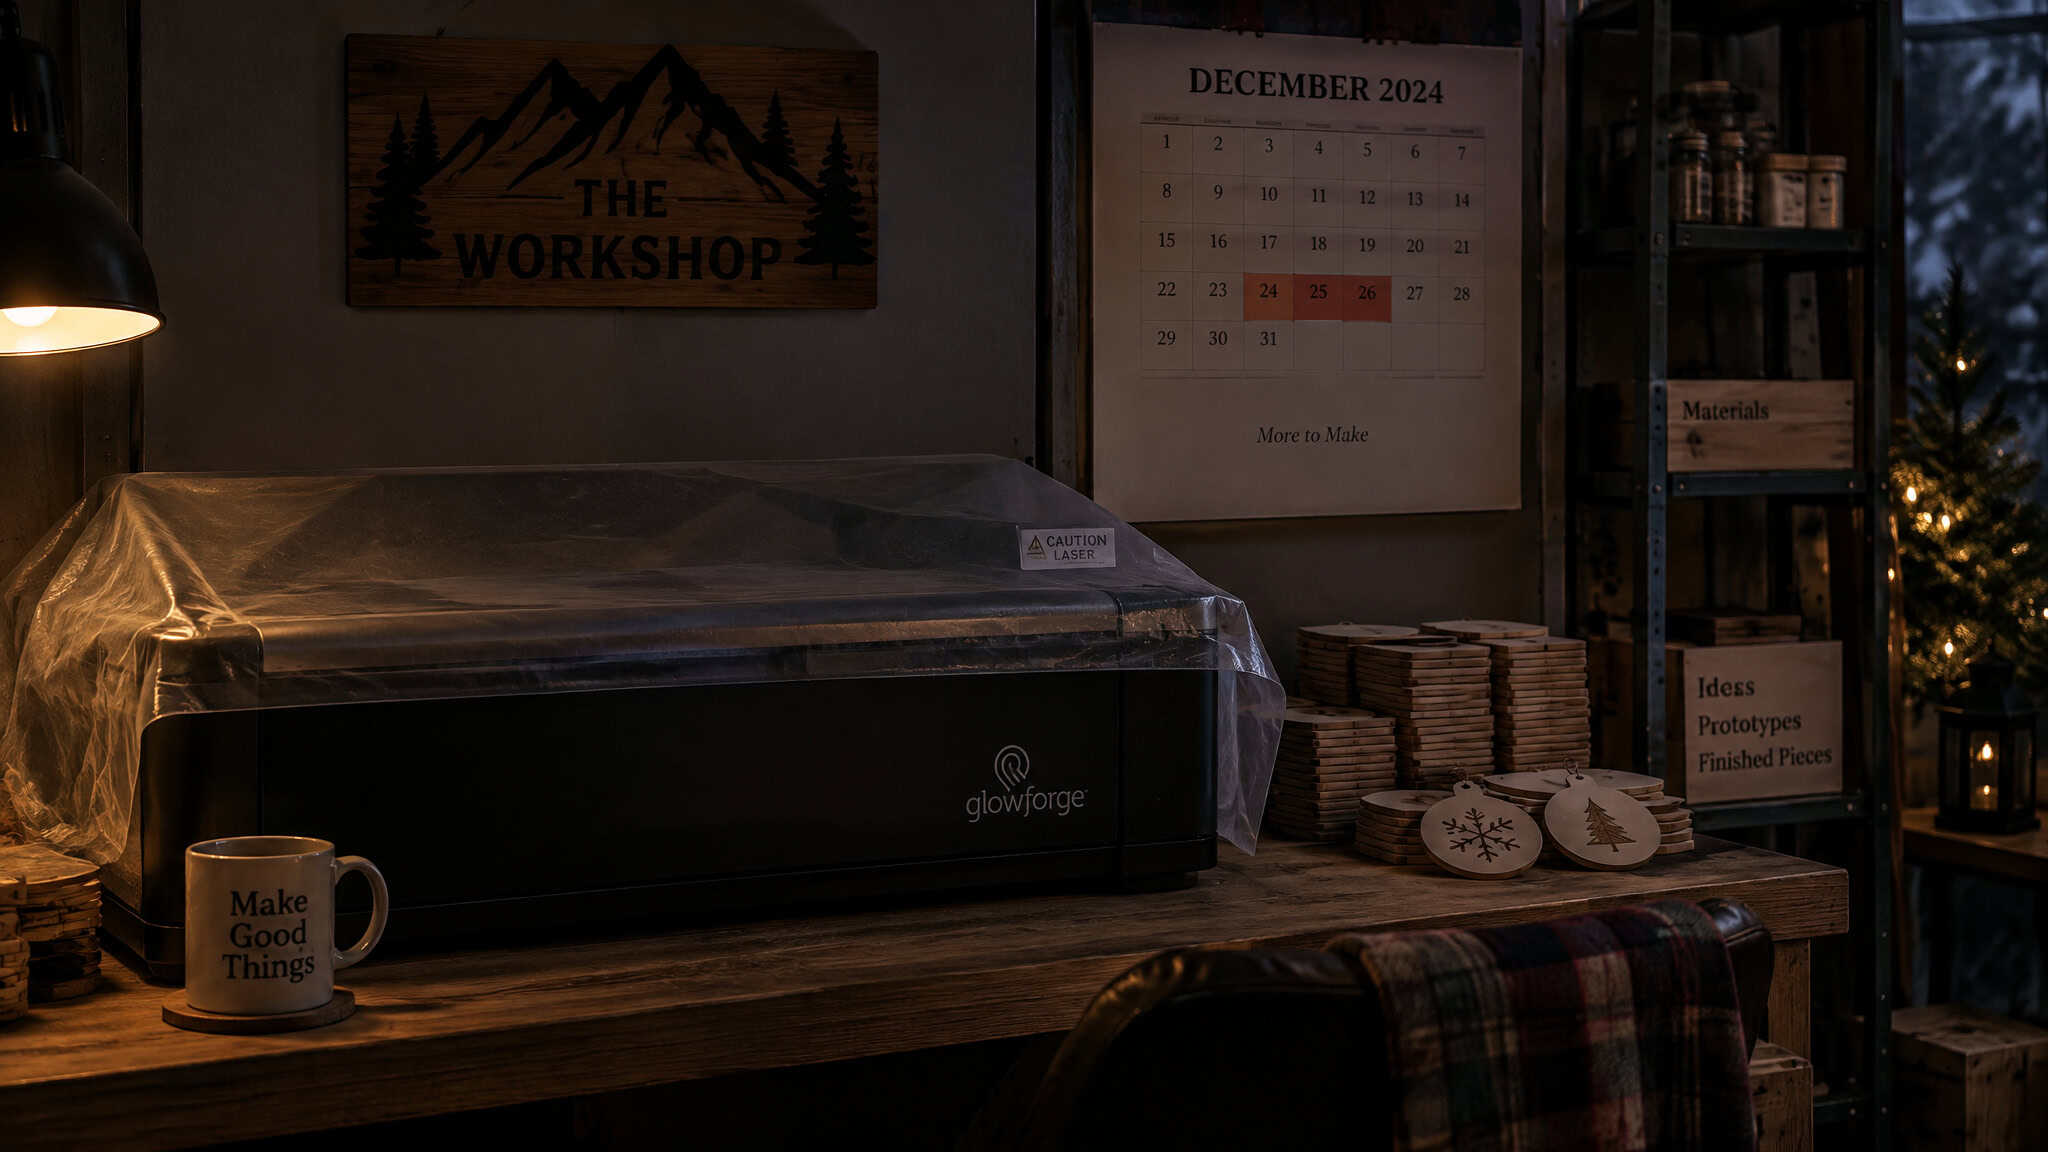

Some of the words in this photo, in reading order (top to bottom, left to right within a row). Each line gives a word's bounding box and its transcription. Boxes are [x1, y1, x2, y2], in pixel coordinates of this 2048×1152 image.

[1189, 67, 1370, 101] DECEMBER
[1379, 78, 1444, 104] 2024
[1163, 134, 1170, 149] 1
[1214, 135, 1223, 151] 2
[1265, 137, 1274, 153] 3
[1314, 140, 1323, 155] 4
[1363, 142, 1372, 157] 5
[1410, 143, 1420, 159] 6
[1457, 145, 1466, 161] 7
[575, 180, 666, 217] THE
[1162, 182, 1172, 199] 8
[1213, 183, 1224, 200] 9
[1261, 186, 1278, 202] 10
[1312, 188, 1326, 203] 11
[1359, 189, 1376, 205] 12
[1407, 191, 1424, 207] 13
[1455, 193, 1470, 208] 14
[1159, 231, 1176, 248] 15
[1210, 233, 1228, 249] 16
[1261, 234, 1278, 250] 17
[1311, 236, 1327, 251] 18
[1359, 237, 1376, 253] 19
[1406, 238, 1424, 253] 20
[1454, 239, 1470, 255] 21
[455, 234, 781, 281] WORKSHOP
[1157, 281, 1177, 297] 22
[1208, 281, 1228, 298] 23
[1259, 283, 1278, 298] 24
[1309, 283, 1328, 299] 25
[1358, 285, 1377, 301] 26
[1406, 285, 1424, 301] 27
[1453, 286, 1471, 301] 28
[1157, 330, 1176, 346] 29
[1208, 330, 1228, 346] 30
[1259, 331, 1277, 346] 31
[1683, 399, 1769, 421] Materials
[1256, 426, 1300, 444] More
[1304, 430, 1321, 443] to
[1325, 425, 1369, 443] Make
[1046, 534, 1107, 548] CAUTION
[1054, 549, 1095, 561] LASER
[1698, 714, 1802, 738] Prototypes
[1699, 748, 1774, 773] Finished
[1779, 747, 1833, 767] Pieces
[230, 888, 308, 917] Make
[229, 918, 307, 949] Good
[222, 953, 315, 984] Things
